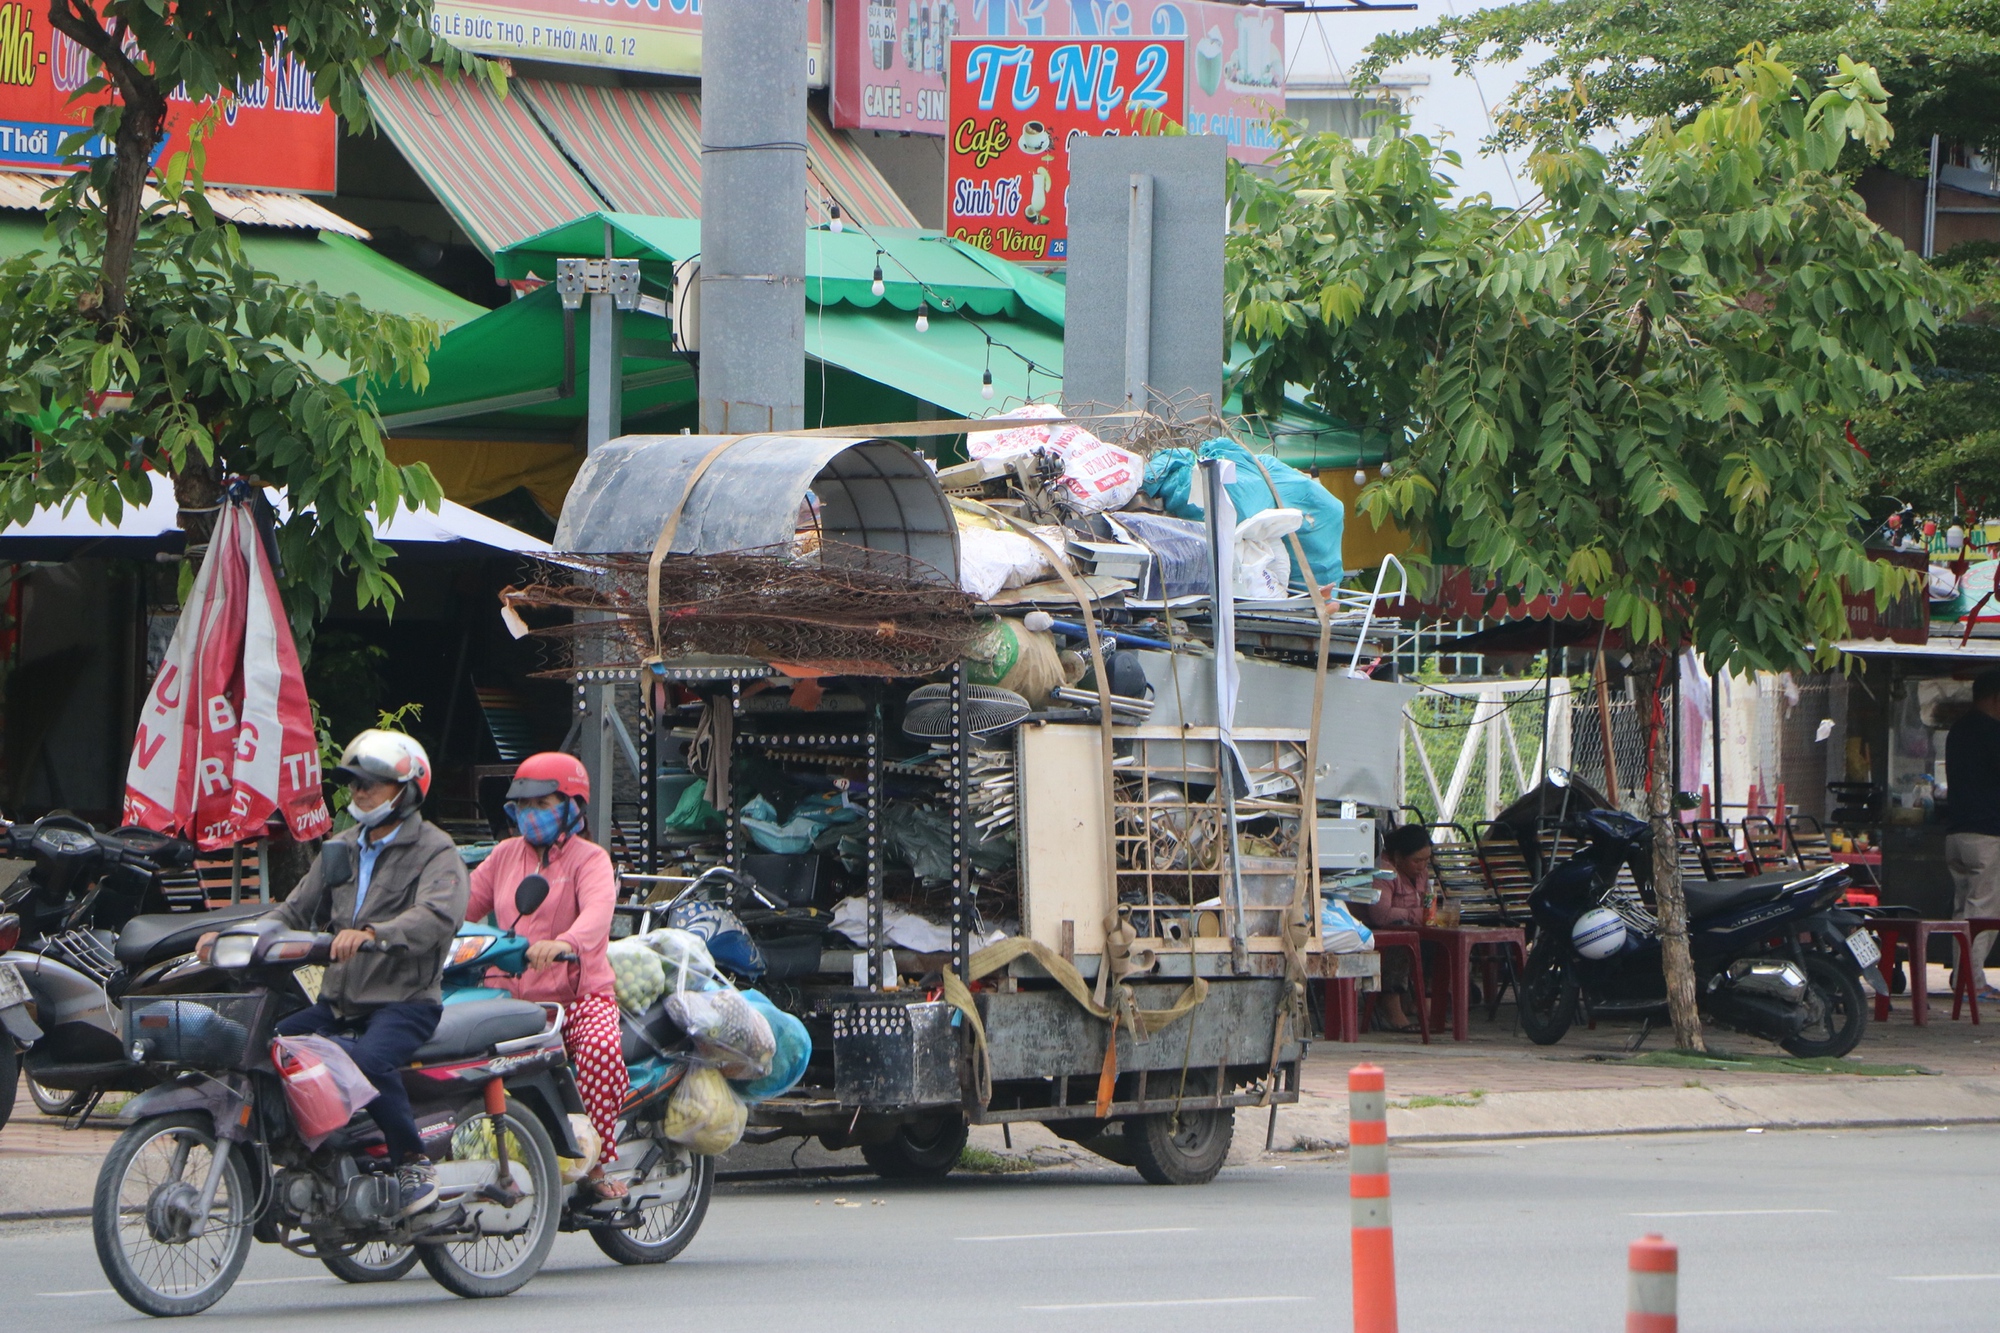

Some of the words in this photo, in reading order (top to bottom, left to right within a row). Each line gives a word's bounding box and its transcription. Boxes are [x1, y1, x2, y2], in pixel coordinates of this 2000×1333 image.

[445, 13, 461, 36] LÊ
[464, 15, 493, 40] ĐỨC
[496, 22, 528, 48] THỌ,
[532, 26, 542, 46] P.
[545, 25, 576, 50] THỚI
[579, 32, 602, 55] AN,
[605, 36, 616, 55] Q.
[620, 37, 636, 56] 12
[863, 80, 901, 118] CAFÉ
[916, 88, 946, 122] SIN
[966, 44, 1040, 111] Tí
[1049, 44, 1124, 120] Nị
[1129, 44, 1169, 110] 2
[0, 126, 48, 155] Thới
[954, 117, 1010, 169] Café
[1210, 107, 1241, 147] GIẢI
[953, 177, 994, 217] Sinh
[994, 174, 1021, 216] Tố
[996, 226, 1047, 258] Võng
[421, 1121, 449, 1135] HONDA
